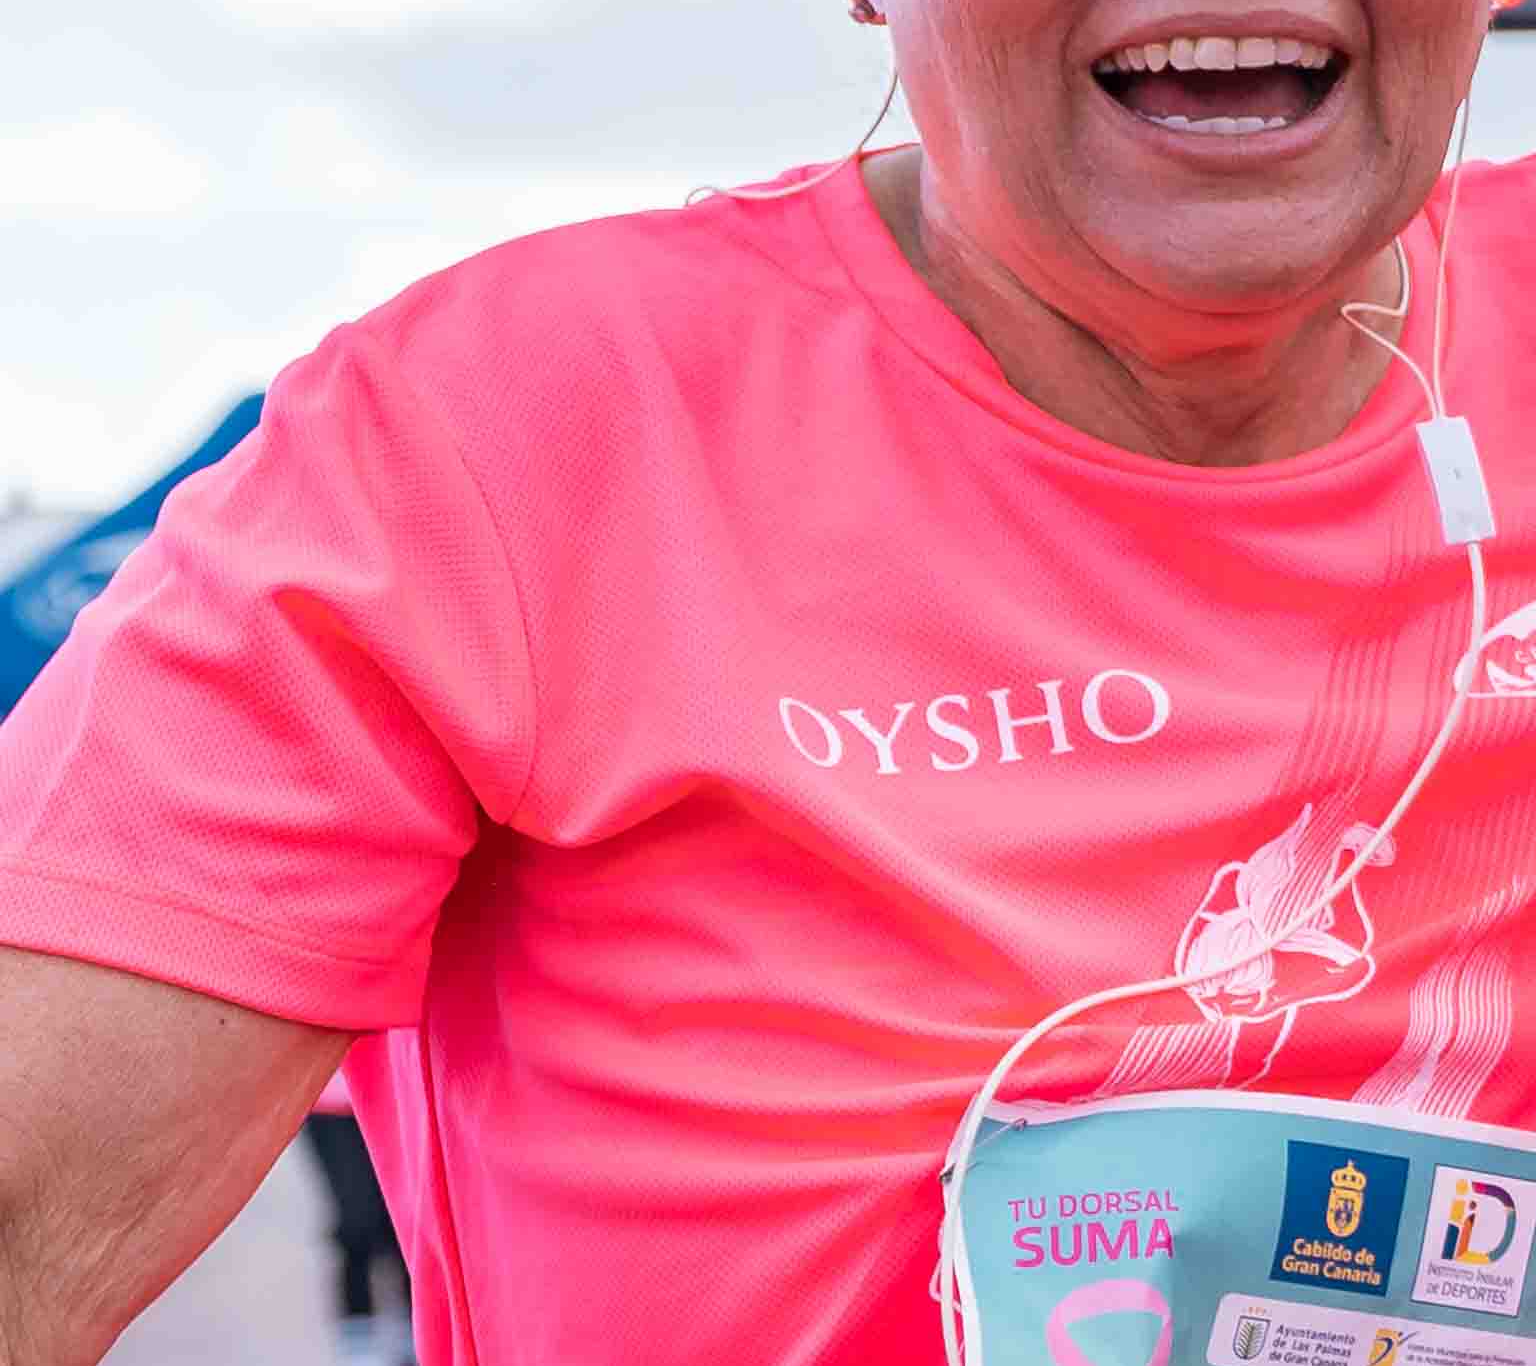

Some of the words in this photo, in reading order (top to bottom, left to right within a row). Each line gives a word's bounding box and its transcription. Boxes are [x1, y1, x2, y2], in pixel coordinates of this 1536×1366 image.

[779, 668, 1169, 776] OYSHO
[1009, 1198, 1047, 1222] TU
[1056, 1188, 1180, 1217] DORSAL
[1013, 1219, 1174, 1268] SUMA
[1292, 1238, 1352, 1265] Cabildo
[1355, 1248, 1375, 1266] de
[1282, 1255, 1319, 1277] Gran
[1323, 1261, 1381, 1286] Canaria
[1441, 1280, 1507, 1306] DEPORTES
[1275, 1324, 1356, 1345] Ayuntamiento
